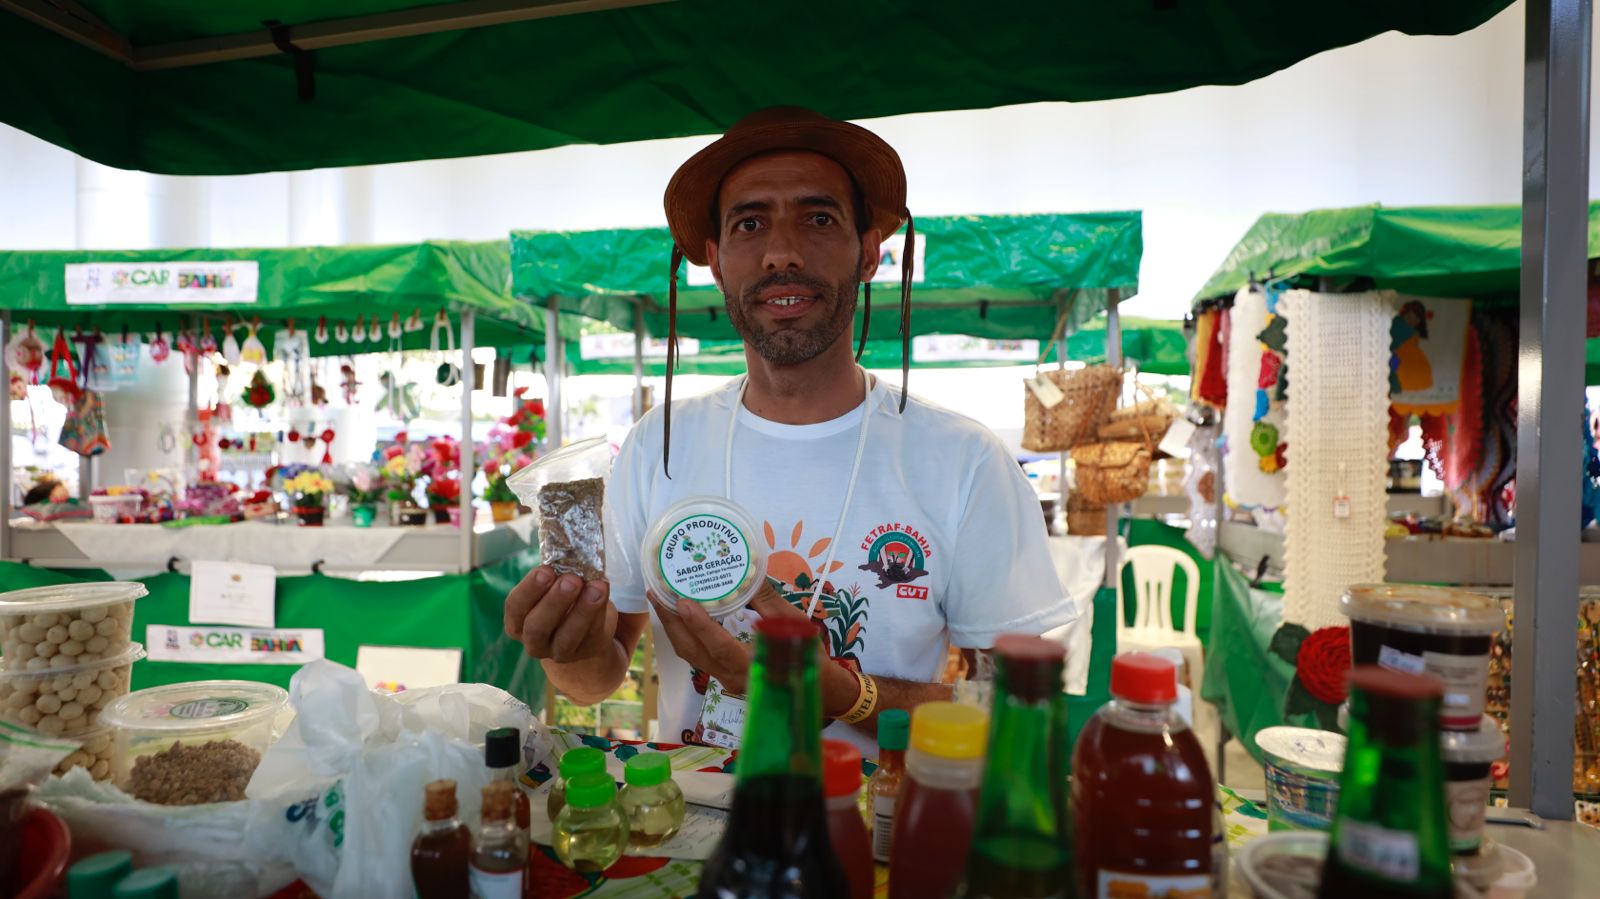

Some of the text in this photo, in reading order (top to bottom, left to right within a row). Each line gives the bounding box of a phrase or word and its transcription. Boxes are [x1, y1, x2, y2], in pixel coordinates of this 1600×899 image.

[130, 269, 170, 286] CAR
[666, 529, 685, 559] GRUPO
[861, 523, 932, 558] FETRAF-BAHIA
[676, 554, 743, 577] SABOR GERAÇÃO
[898, 586, 927, 598] CUT
[206, 632, 303, 652] CAR BAHIA
